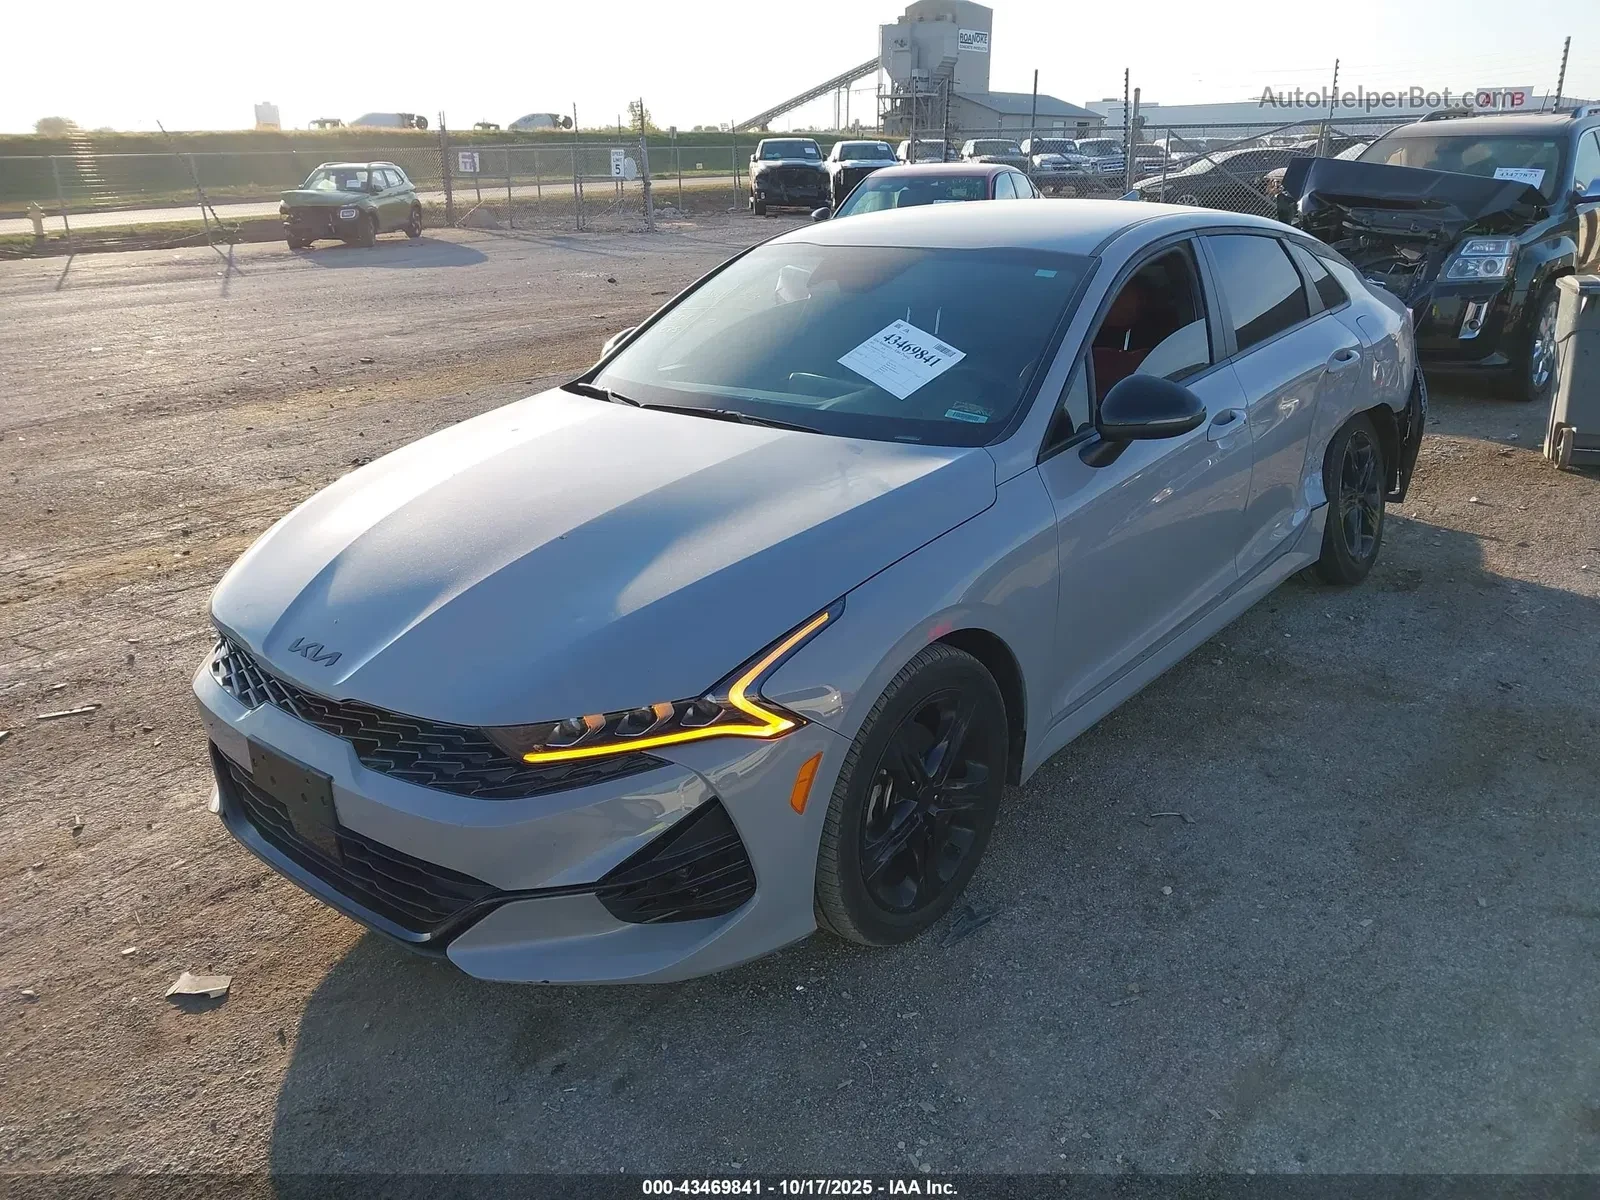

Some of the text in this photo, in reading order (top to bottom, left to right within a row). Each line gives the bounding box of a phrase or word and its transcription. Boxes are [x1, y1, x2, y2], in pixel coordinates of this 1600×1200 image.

[960, 32, 988, 45] ROANOKE
[615, 163, 621, 175] 5
[883, 333, 942, 368] 43469841
